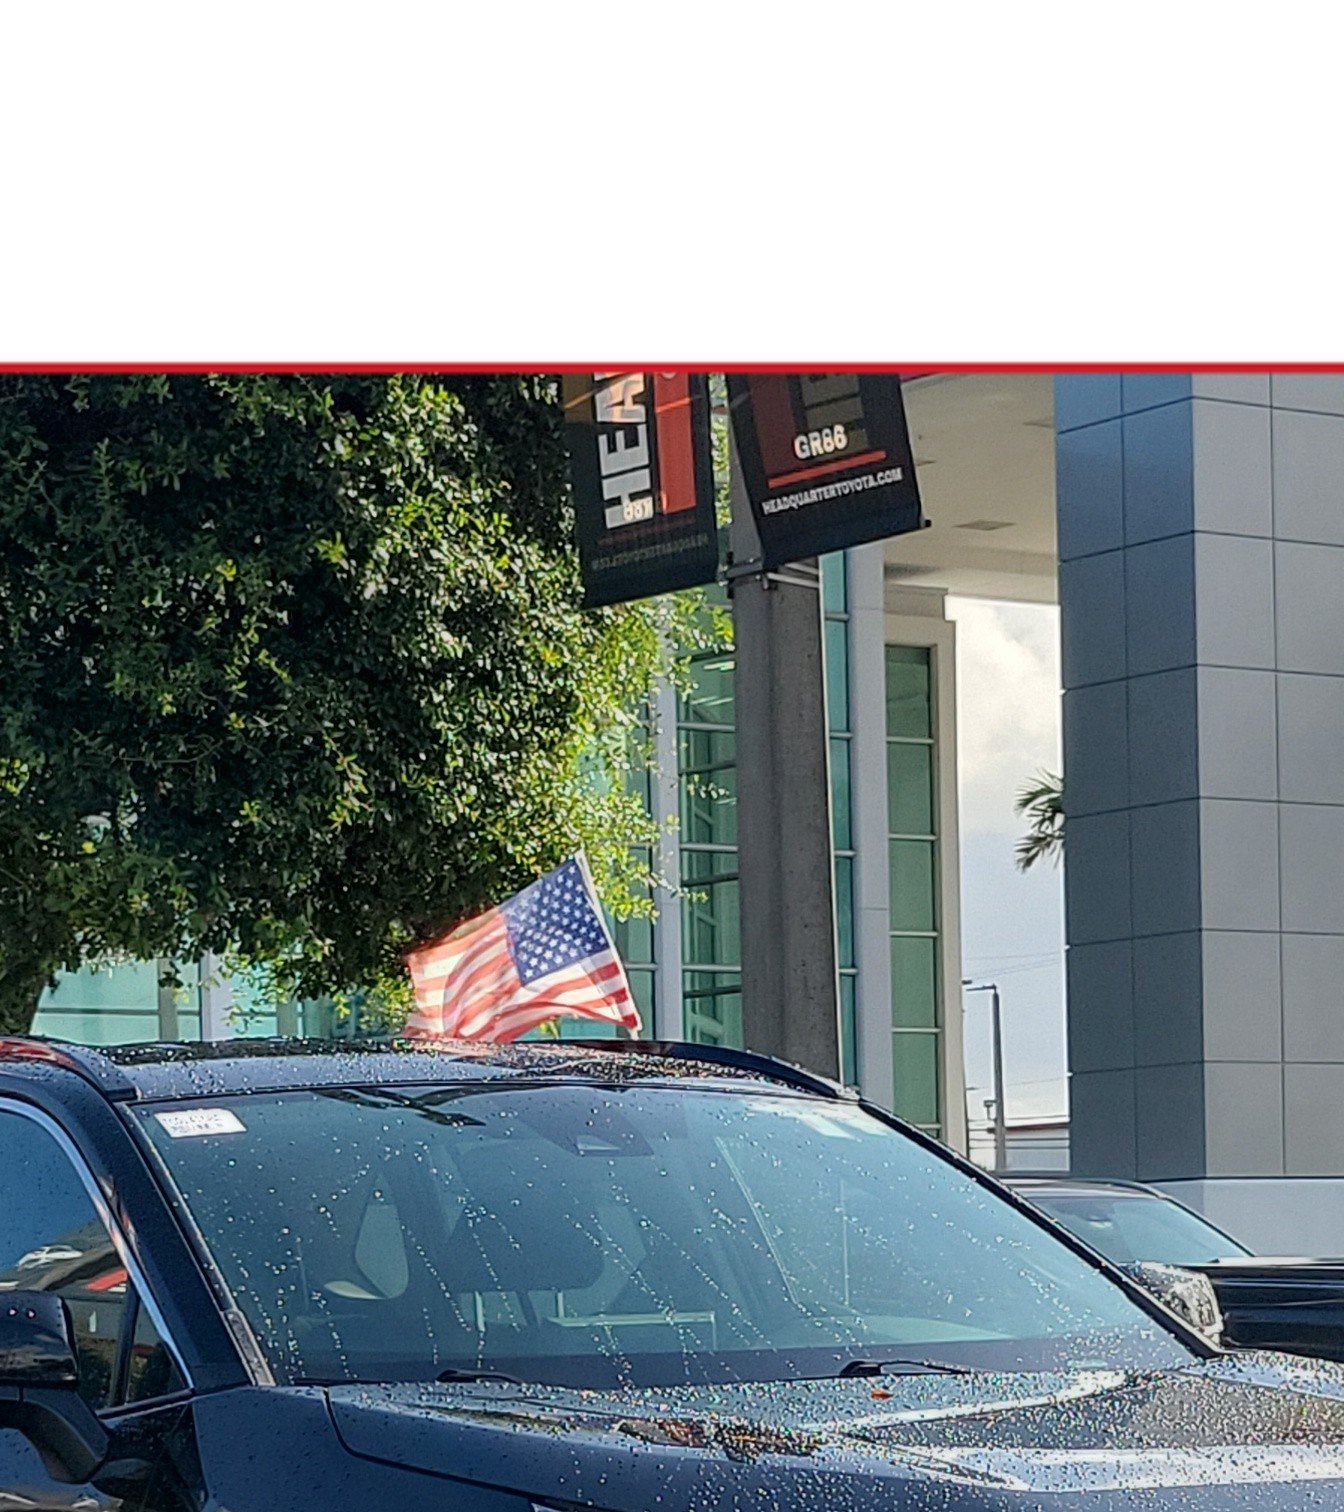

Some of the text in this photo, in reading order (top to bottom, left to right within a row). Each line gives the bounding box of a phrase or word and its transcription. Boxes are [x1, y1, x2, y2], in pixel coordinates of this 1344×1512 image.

[592, 372, 654, 529] HEA
[794, 424, 848, 460] GR86
[761, 467, 904, 515] HEADQUARTERTOYOTA.COM
